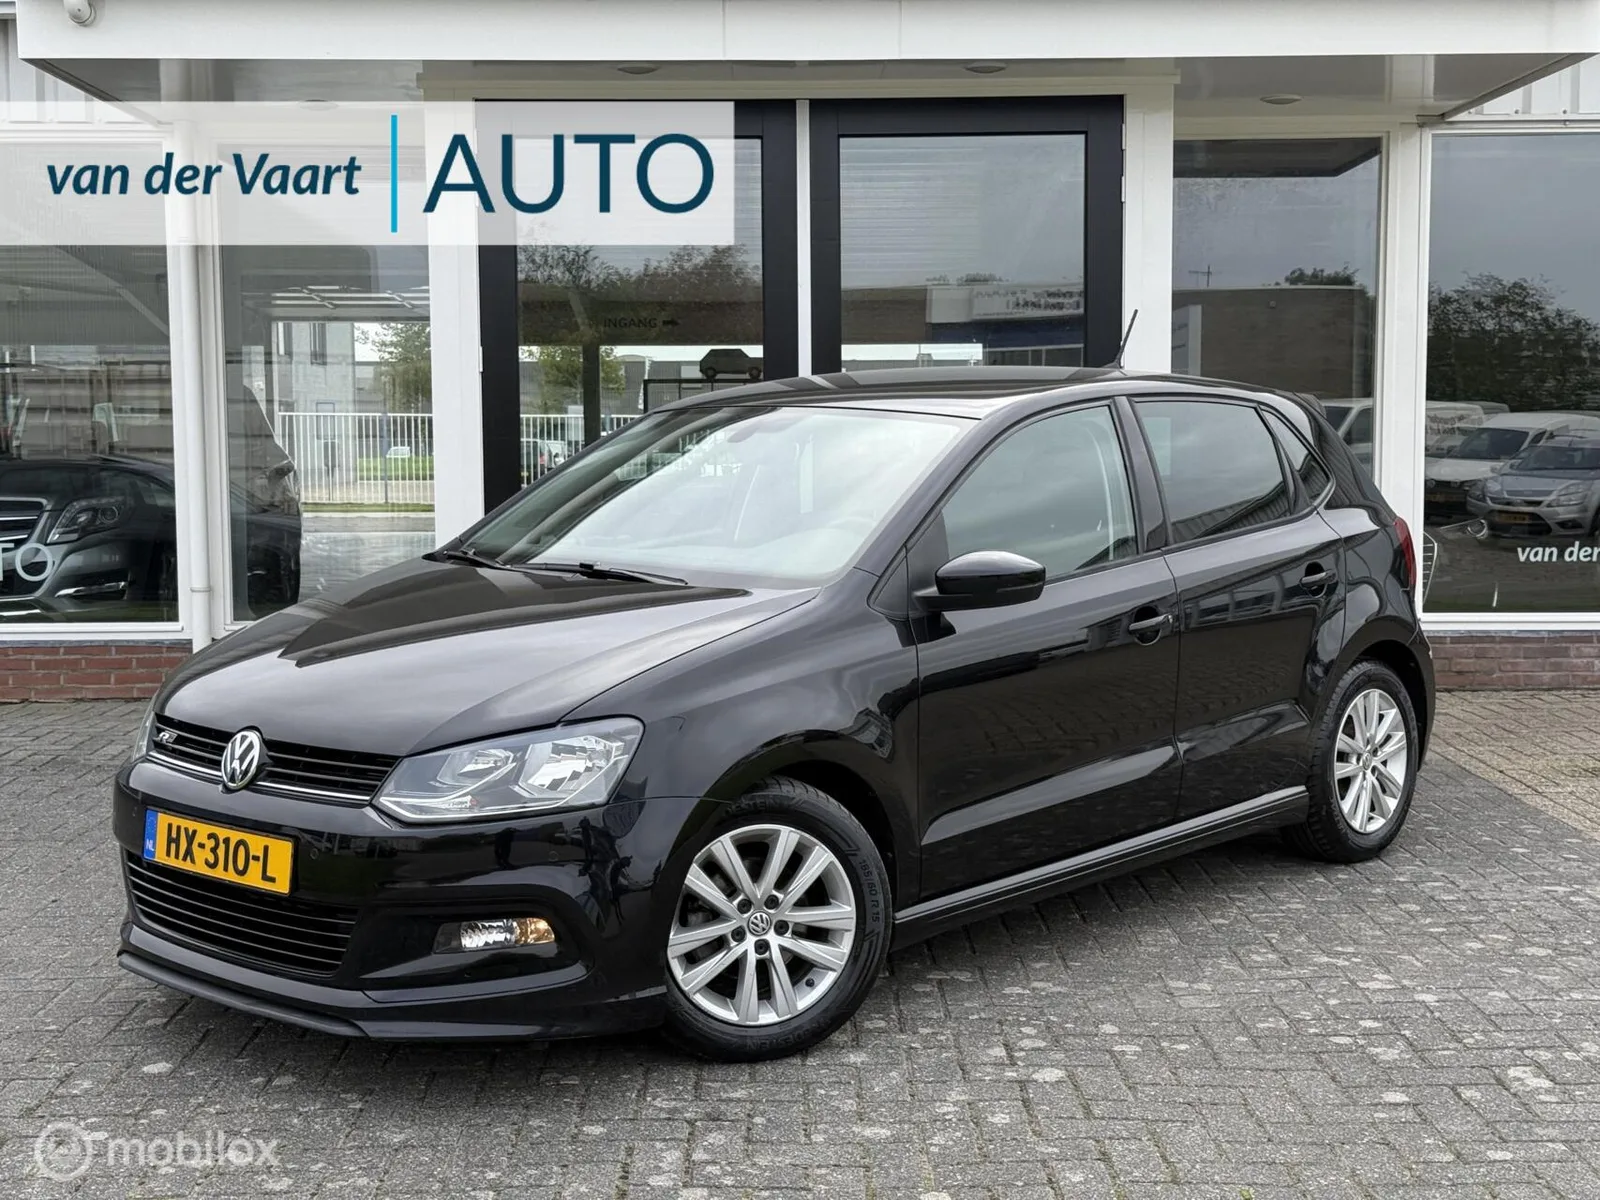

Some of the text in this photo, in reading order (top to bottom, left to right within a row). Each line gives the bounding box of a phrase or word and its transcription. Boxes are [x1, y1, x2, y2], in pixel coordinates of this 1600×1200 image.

[603, 317, 658, 329] INGANG
[1517, 547, 1558, 562] van
[145, 838, 155, 852] NL
[165, 822, 276, 883] HX-310-L
